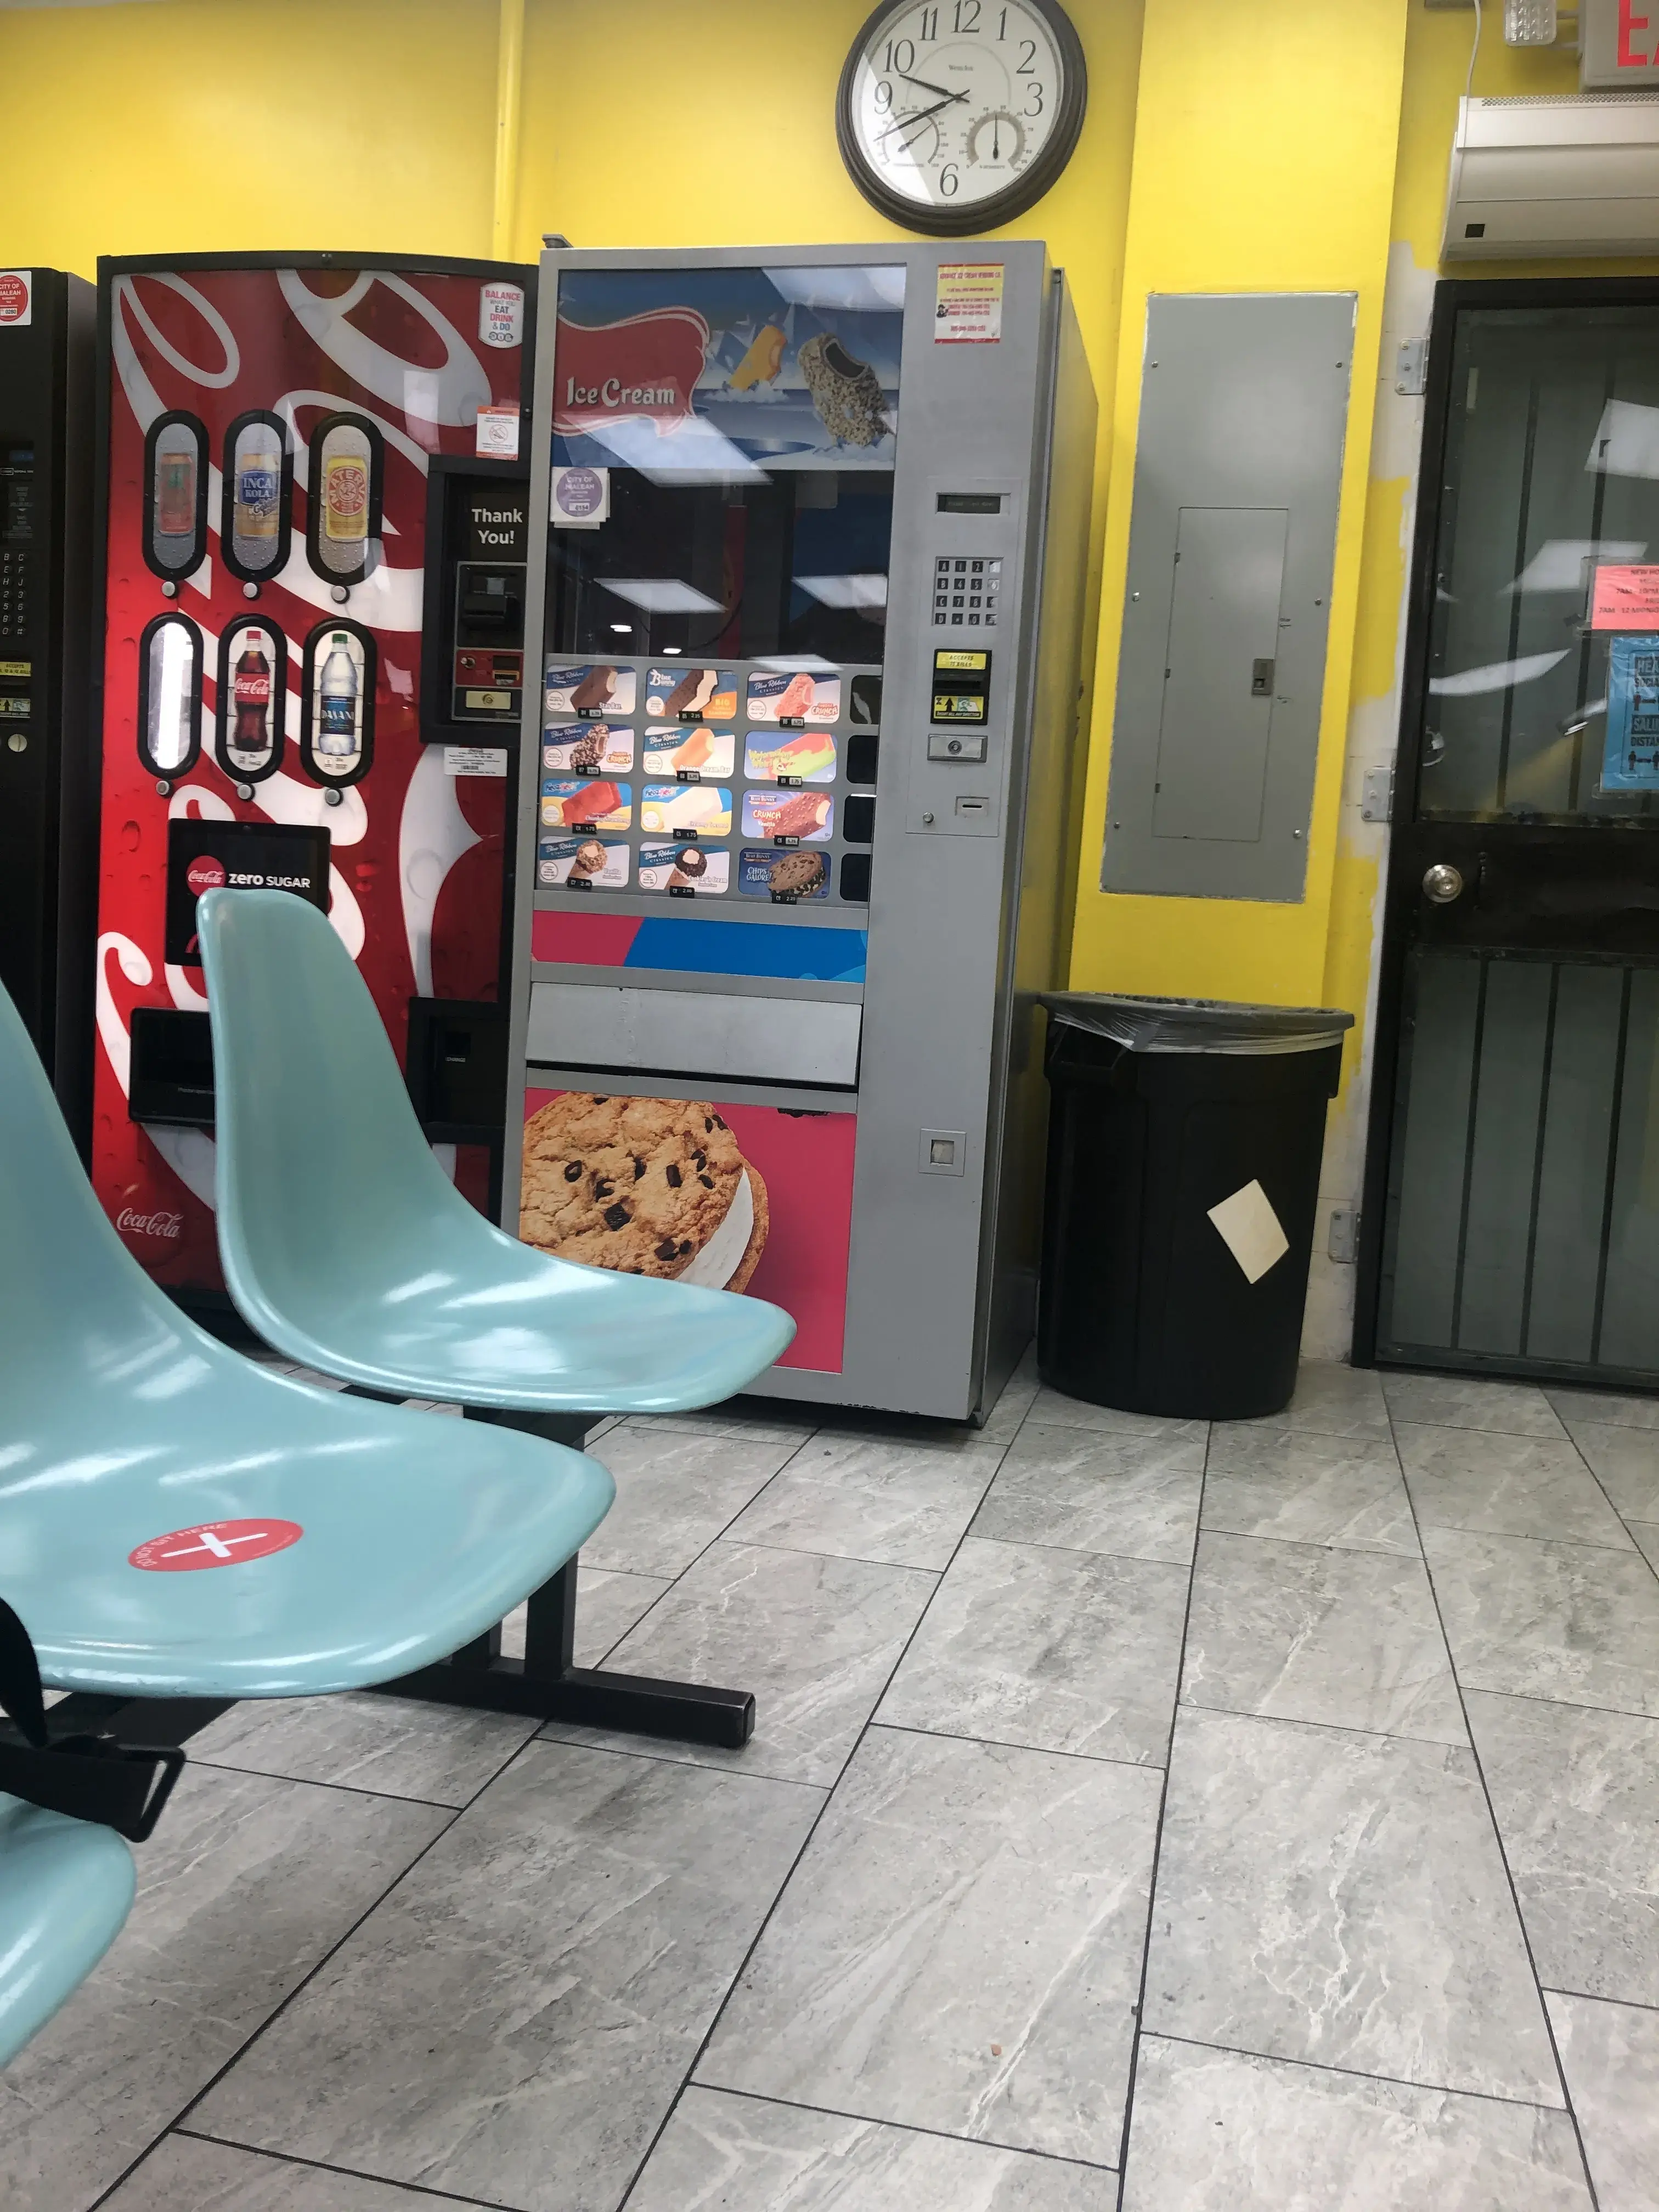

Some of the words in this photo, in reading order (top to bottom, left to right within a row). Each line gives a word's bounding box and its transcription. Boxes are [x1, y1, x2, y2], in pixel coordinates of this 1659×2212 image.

[951, 0, 981, 33] 12
[918, 7, 938, 41] 11
[996, 7, 1007, 41] 1
[882, 39, 915, 74] 10
[1016, 40, 1036, 74] 2
[874, 81, 893, 114] 9
[1024, 82, 1043, 117] 3
[940, 163, 959, 196] 6
[485, 290, 521, 301] BALANCE
[495, 305, 509, 314] EAT
[490, 313, 514, 323] DRINK
[499, 323, 511, 331] DO
[567, 376, 599, 407] Ice
[601, 377, 675, 408] Cream
[243, 477, 273, 489] INCA
[329, 470, 365, 504] MATERVA
[245, 489, 270, 498] KOLA
[471, 508, 523, 523] Thank
[477, 529, 515, 544] You!
[941, 562, 946, 571] A
[975, 563, 980, 571] 2
[958, 580, 962, 589] 4
[974, 580, 979, 590] 5
[940, 597, 944, 606] C
[957, 598, 961, 606] 7
[973, 598, 978, 607] 8
[754, 682, 768, 690] Blue
[768, 679, 787, 688] Ribbon
[812, 706, 838, 714] CRUNCH
[649, 736, 662, 744] Blue
[662, 733, 681, 742] Ribbon
[607, 754, 631, 763] CRUNCH
[753, 809, 782, 820] CRUNCH
[748, 866, 767, 874] CHIPS
[228, 873, 264, 885] zero
[266, 876, 311, 888] SUGAR
[747, 873, 772, 882] GALORE!
[116, 1207, 184, 1238] Coca-Cola
[150, 1536, 175, 1546] SIT
[177, 1523, 228, 1537] HERE
